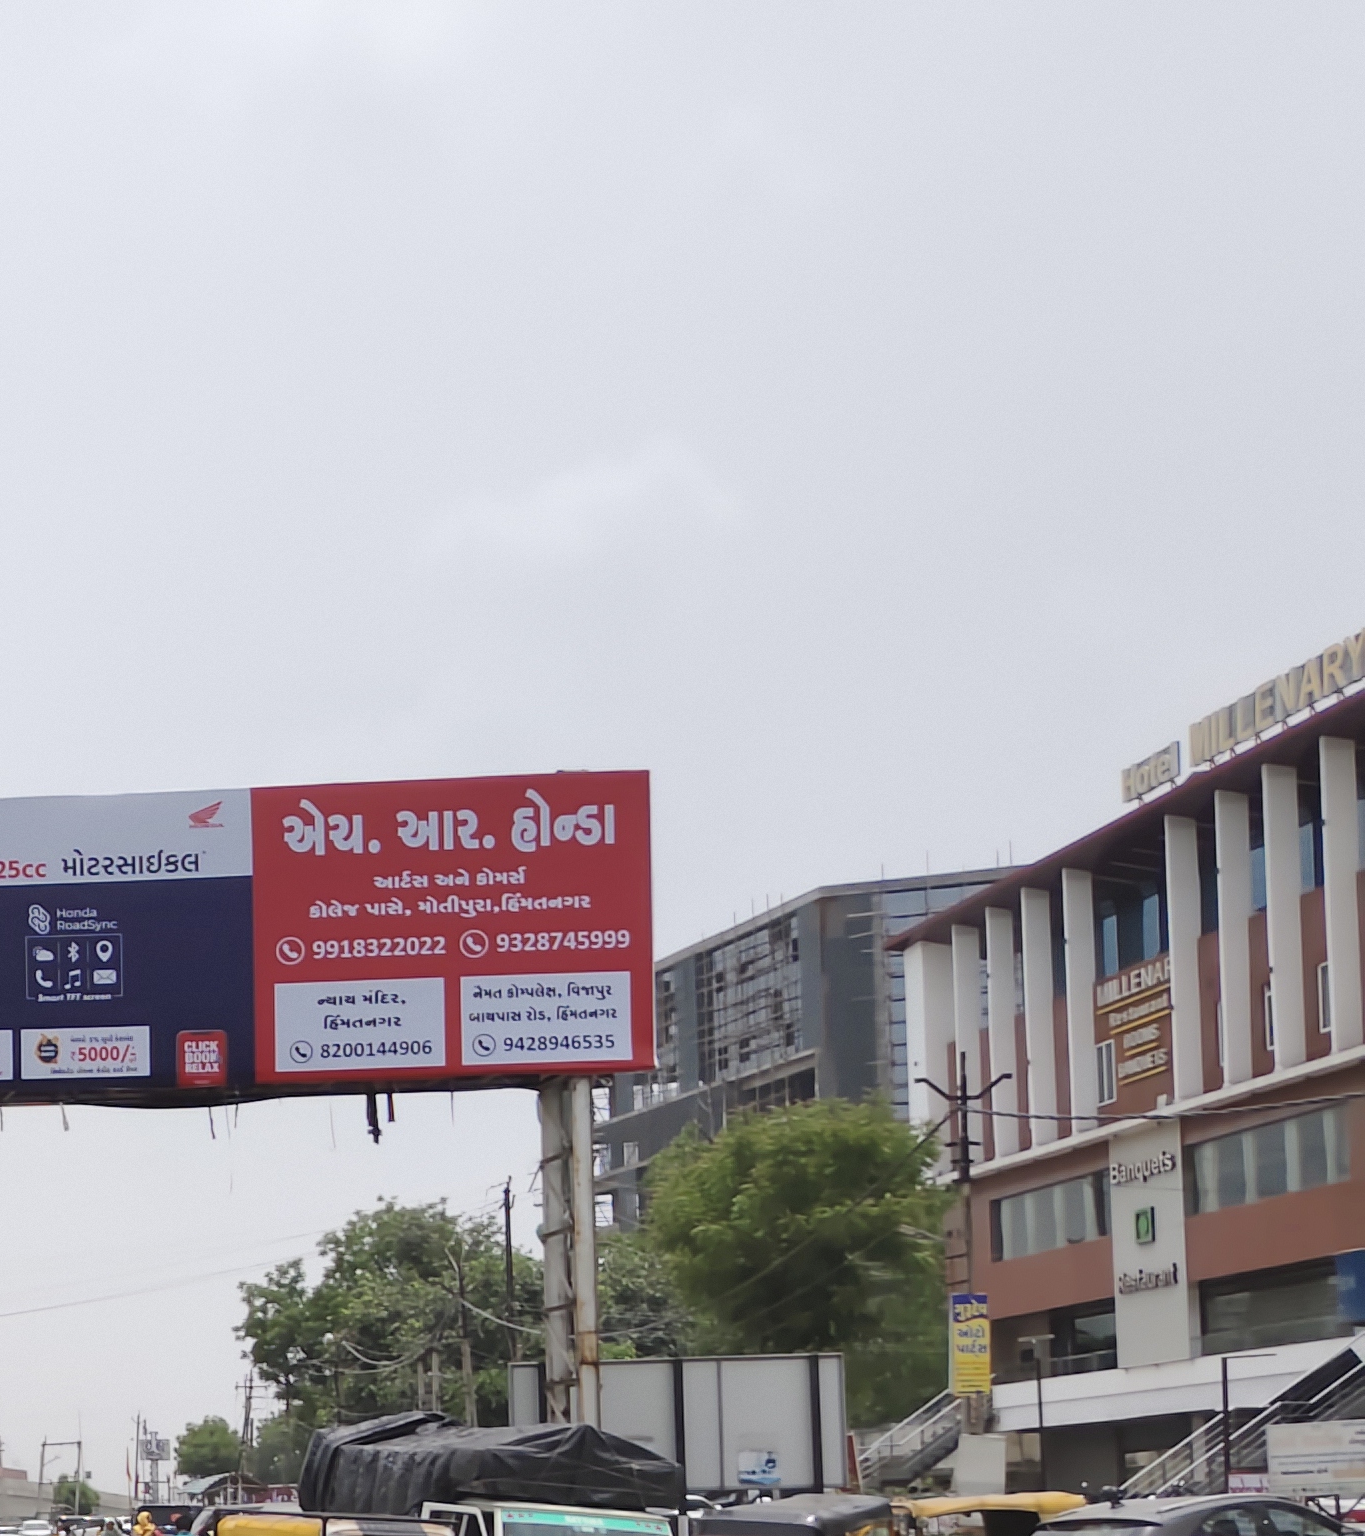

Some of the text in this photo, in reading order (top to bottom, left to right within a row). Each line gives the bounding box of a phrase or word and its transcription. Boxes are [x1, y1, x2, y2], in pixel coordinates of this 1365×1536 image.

[1121, 627, 1365, 803] Hotel MILLENARY
[282, 788, 615, 856] એચ. આર. હોન્ડા
[62, 849, 200, 877] મોટરસાઈકલ
[434, 868, 470, 886] અને
[476, 866, 527, 886] કોમર્સ
[56, 908, 97, 919] Honda
[309, 901, 359, 918] કોલેજ
[365, 898, 411, 917] પાસે,
[56, 919, 118, 931] RoadSync
[312, 937, 446, 959] 9918322022
[496, 930, 630, 952] 9328745999
[556, 1004, 618, 1021] હિંમતનગર
[324, 1015, 402, 1031] હિંમતનગર
[184, 1041, 219, 1052] CLICK
[321, 1040, 432, 1058] 8200144906
[503, 1035, 615, 1051] 9428946535
[185, 1063, 219, 1073] RELAX
[1110, 1151, 1176, 1185] Banquets
